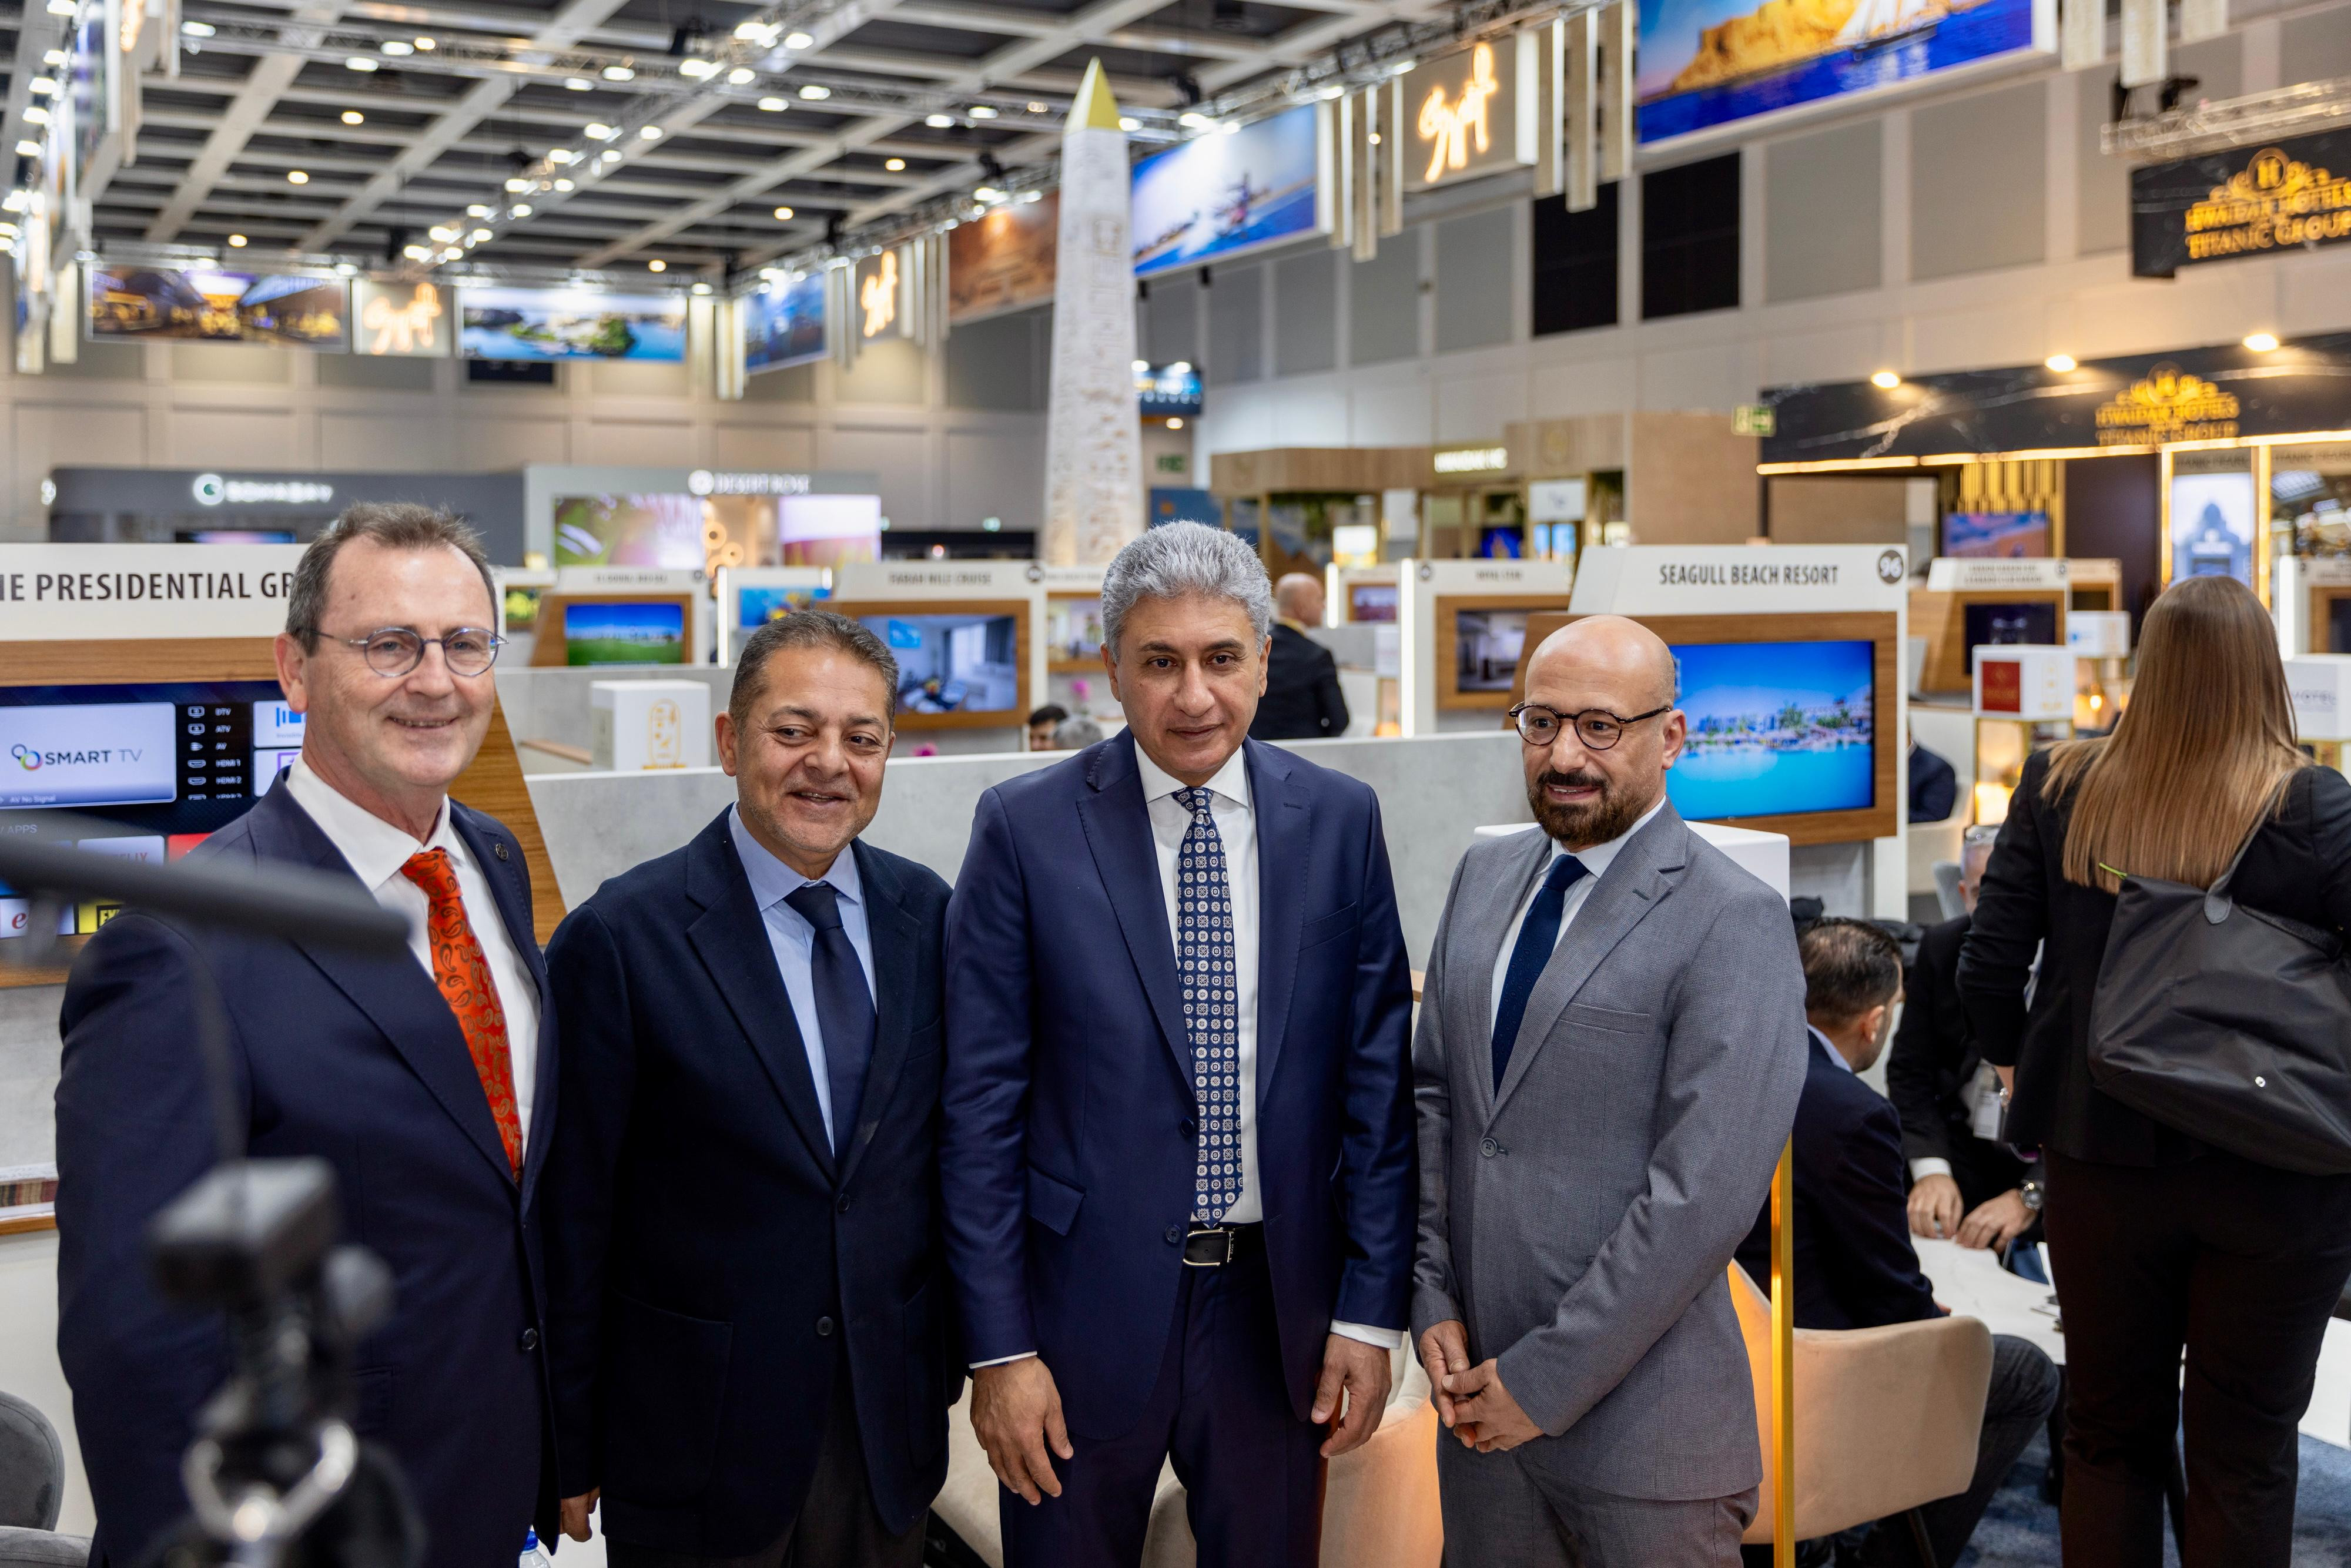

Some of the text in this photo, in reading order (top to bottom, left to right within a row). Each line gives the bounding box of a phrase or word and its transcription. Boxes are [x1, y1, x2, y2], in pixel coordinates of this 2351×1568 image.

[1659, 564, 1839, 585] SEAGULL BEACH RESORT
[1879, 555, 1904, 578] 96
[36, 572, 252, 601] PRESIDENTIAL
[45, 749, 143, 765] SMART TV
[8, 824, 38, 834] APPS
